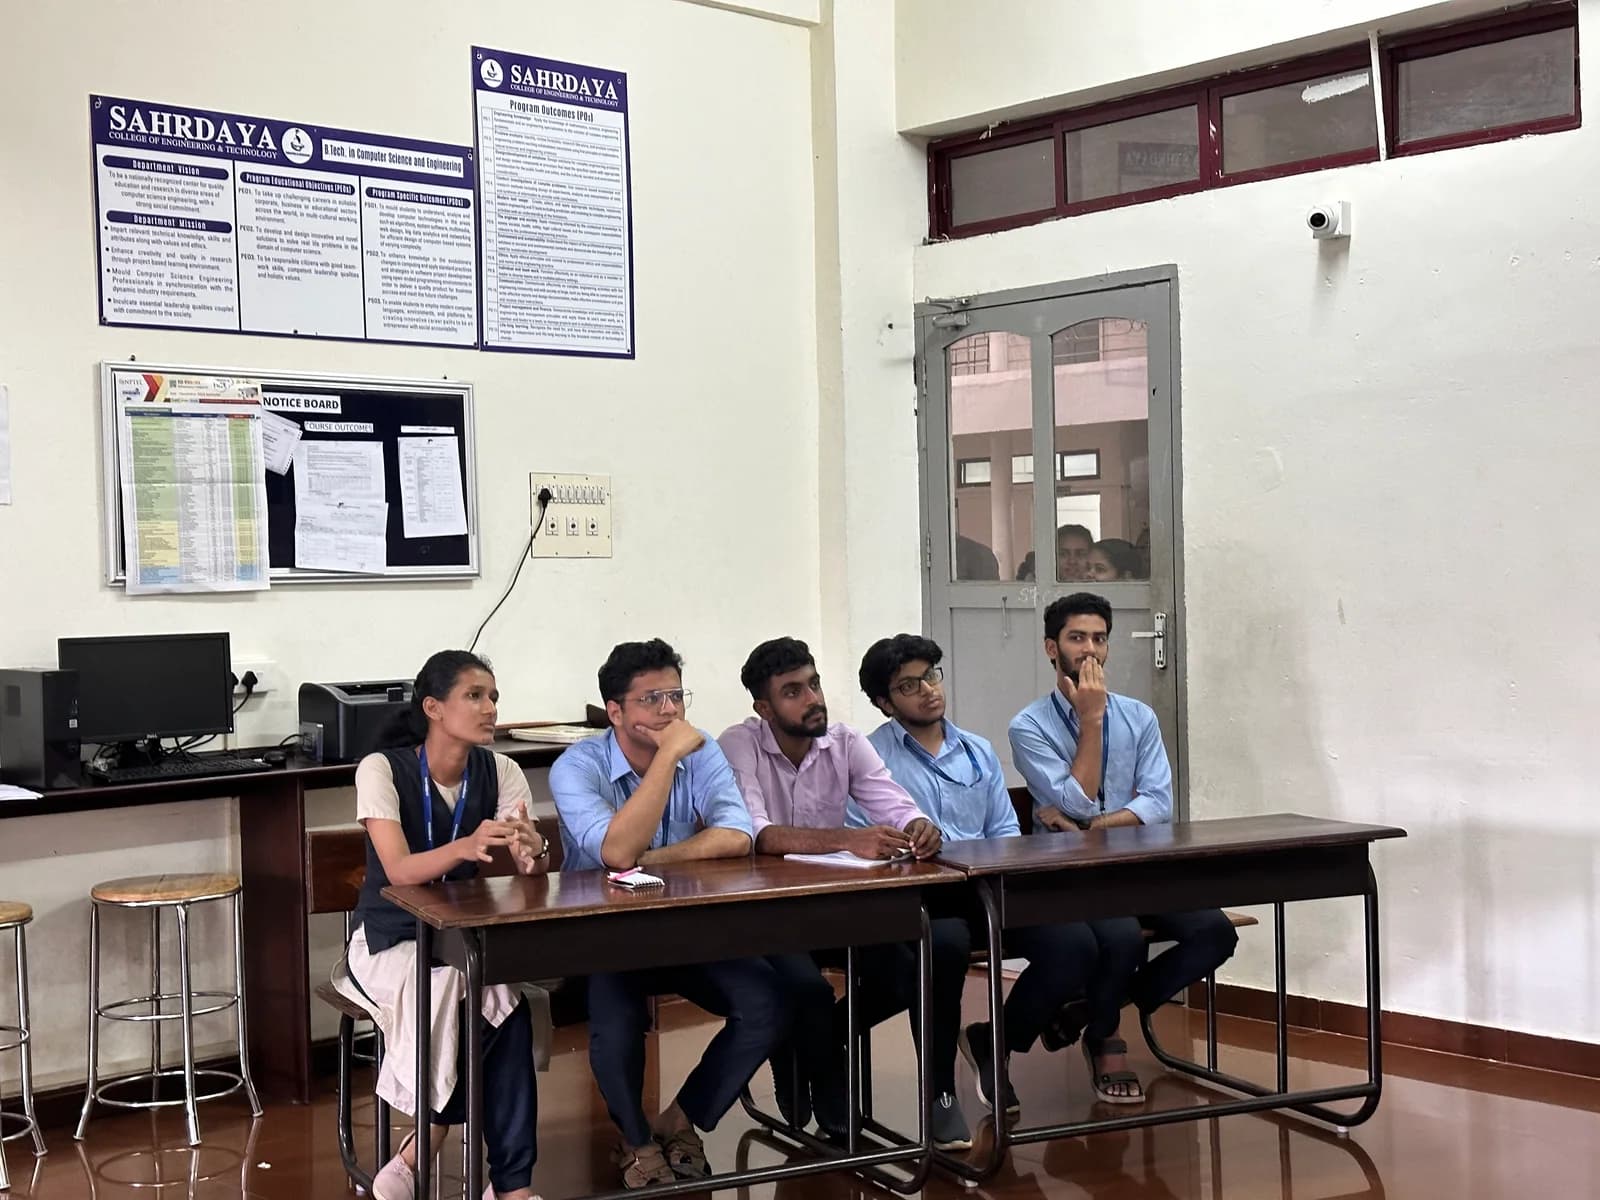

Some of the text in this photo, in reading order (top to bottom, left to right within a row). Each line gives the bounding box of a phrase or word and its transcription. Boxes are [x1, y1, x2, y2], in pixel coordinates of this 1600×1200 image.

[511, 65, 618, 100] SAHRDAYA
[510, 84, 535, 93] COLLEGE
[544, 89, 578, 100] ENGINEERING
[585, 96, 618, 107] TECHNOLOGY
[510, 100, 539, 114] Program
[542, 105, 575, 119] Outcomes
[110, 106, 277, 150] SAHRDAYA
[109, 131, 147, 142] COLLEGE
[162, 138, 215, 151] ENGINEERING
[225, 146, 277, 159] TECHNOLOGY
[133, 160, 199, 175] Department Vision
[357, 148, 386, 162] Computer
[388, 152, 412, 166] Science
[414, 157, 425, 167] and
[427, 157, 461, 173] Engineering
[246, 173, 270, 184] Program
[271, 176, 304, 188] Educational
[305, 181, 334, 191] Objectives
[372, 188, 395, 198] Program
[397, 192, 419, 201] Specific
[420, 194, 446, 204] Outcomes
[134, 215, 206, 229] Department Mission
[152, 230, 175, 238] technical
[111, 246, 133, 254] Enhance
[112, 267, 233, 285] Mould Computer Science Engineering
[112, 276, 154, 286] Professionals
[137, 288, 159, 296] industry
[263, 397, 339, 410] NOTICE BOARD
